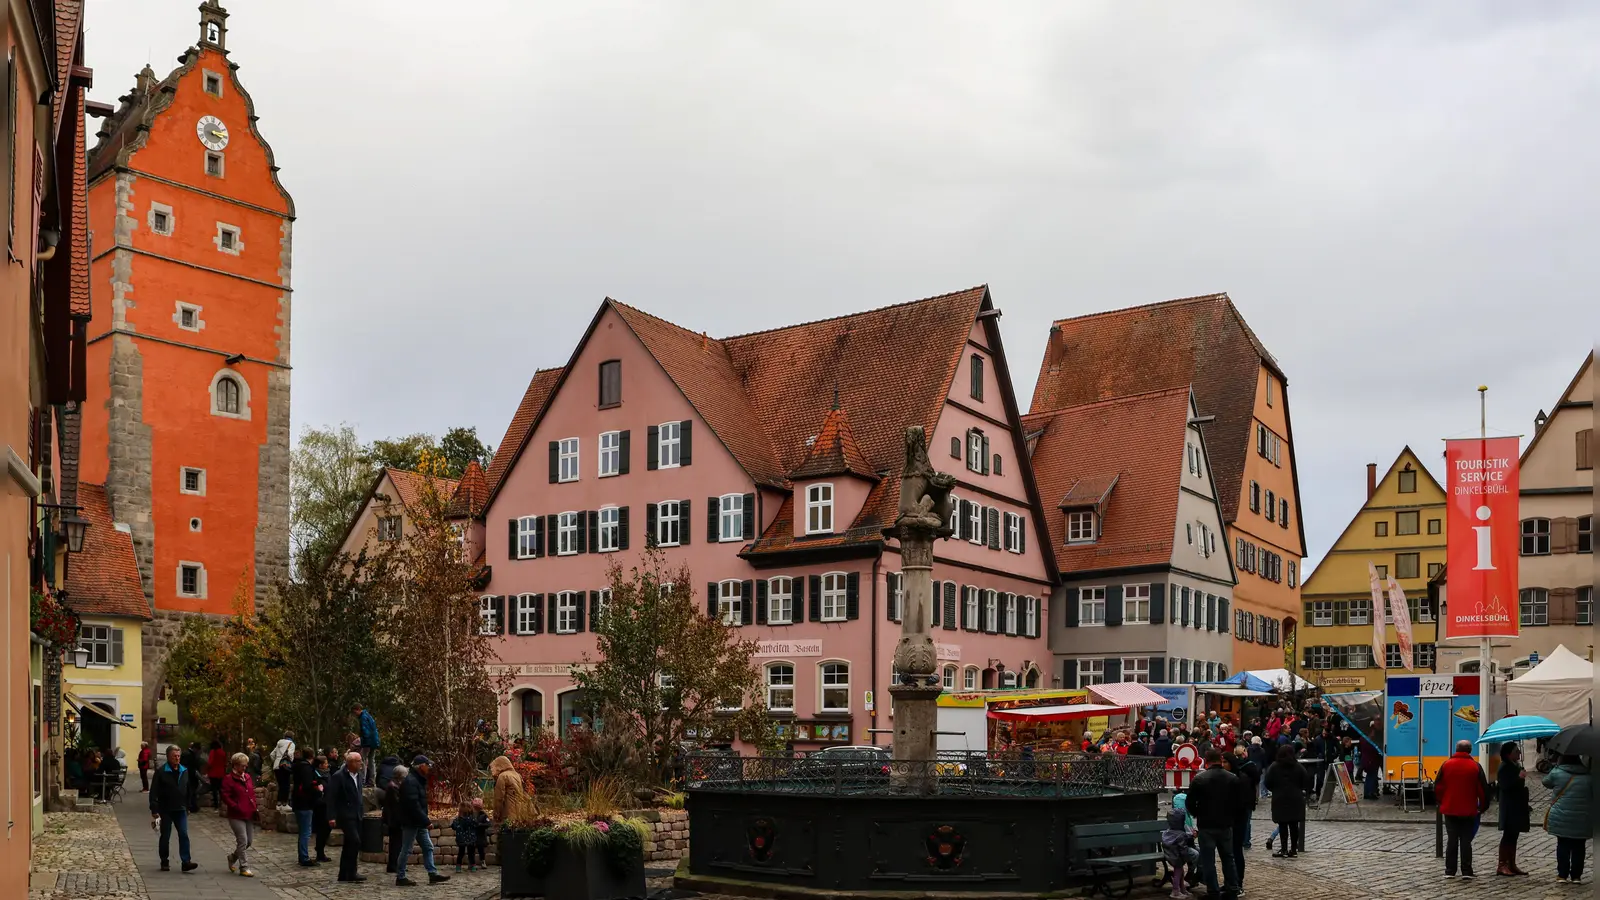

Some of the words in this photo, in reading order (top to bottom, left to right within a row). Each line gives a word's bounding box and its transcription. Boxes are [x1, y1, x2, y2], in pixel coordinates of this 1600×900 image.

[1455, 458, 1509, 470] TOURISTIK
[1461, 471, 1503, 482] SERVICE
[1454, 484, 1509, 496] DINKELSBÜHL
[1472, 505, 1497, 571] i
[1455, 613, 1510, 623] DINKELSBÜHL
